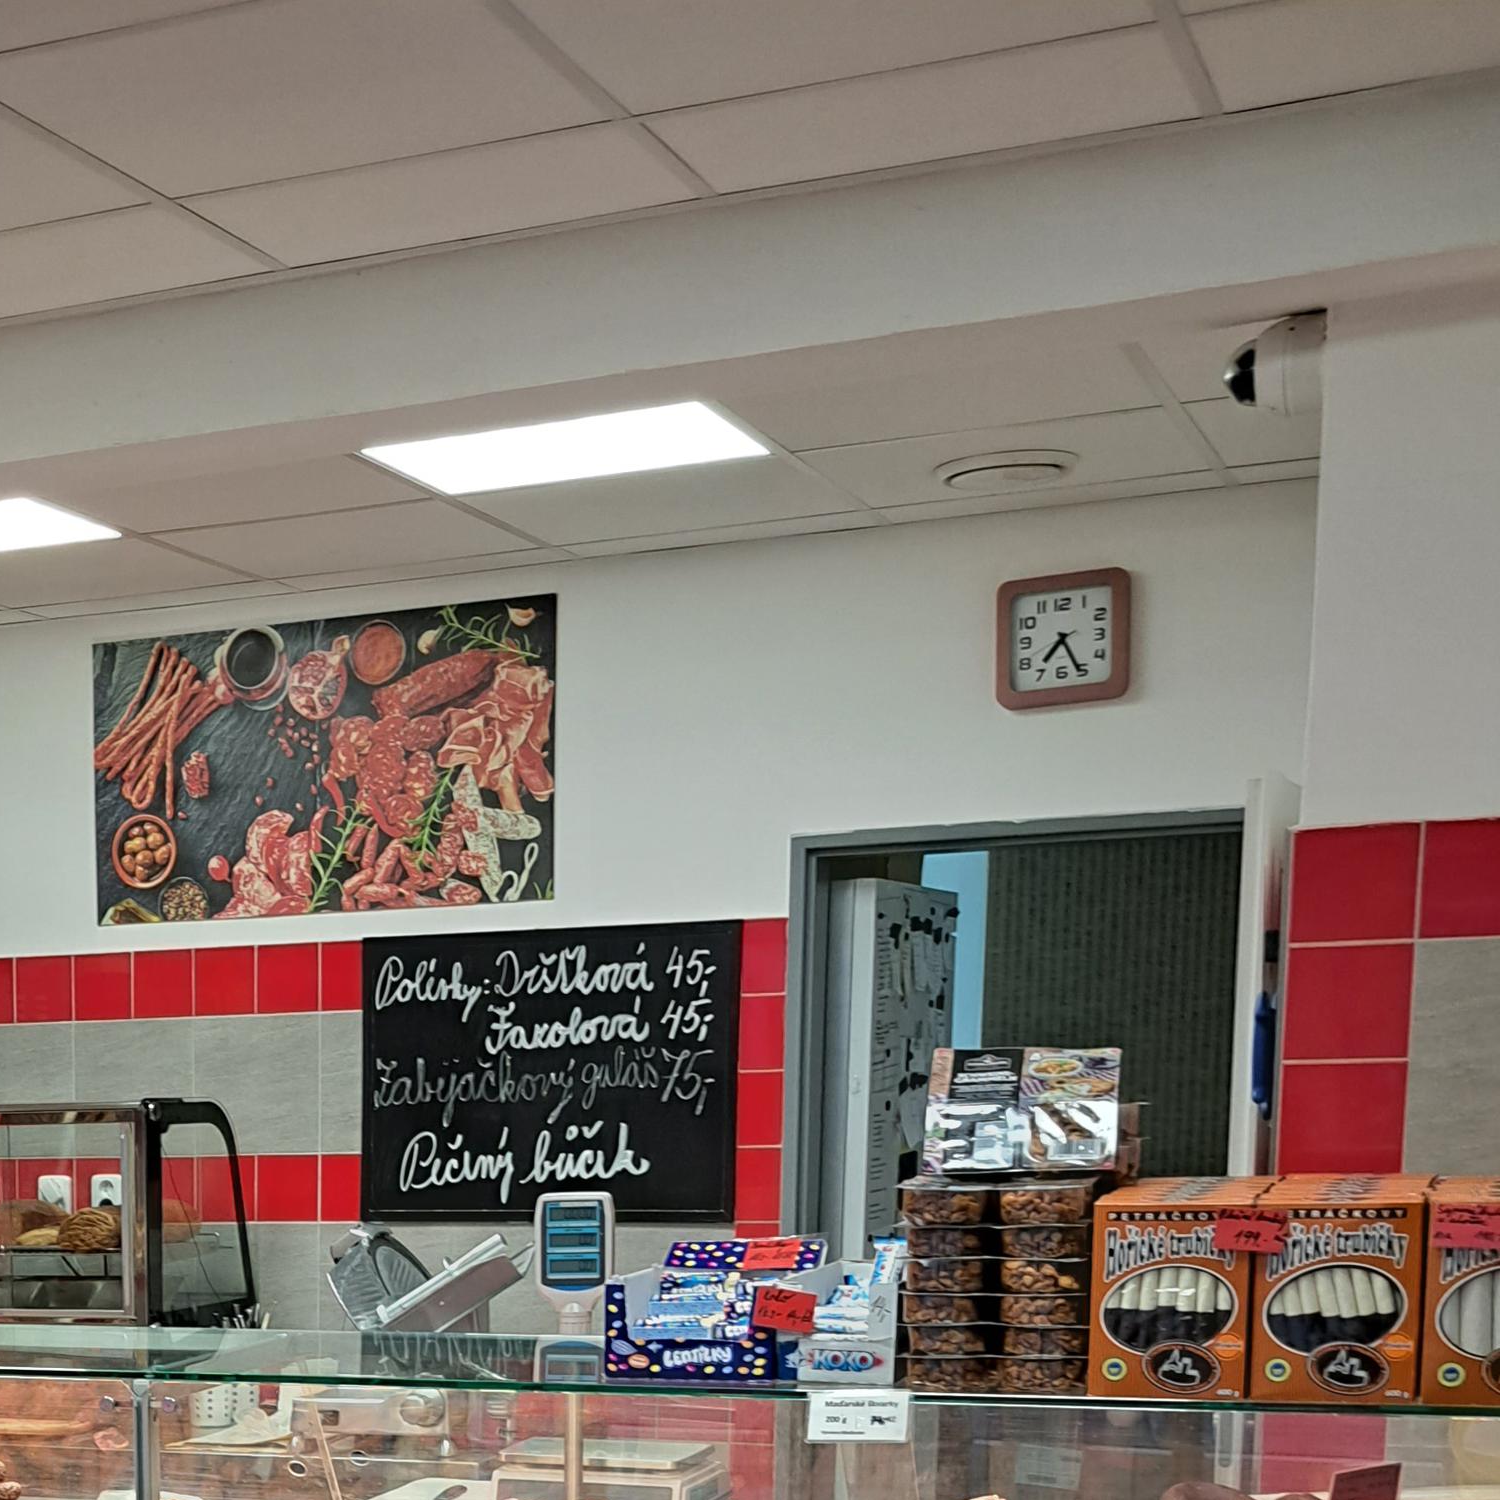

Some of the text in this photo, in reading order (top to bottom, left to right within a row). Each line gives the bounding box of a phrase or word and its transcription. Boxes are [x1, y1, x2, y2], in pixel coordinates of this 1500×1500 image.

[1037, 601, 1047, 614] 11
[1054, 598, 1072, 612] 12
[1093, 607, 1107, 621] 2
[1019, 617, 1037, 630] 10
[1093, 627, 1106, 641] 3
[1019, 636, 1032, 650] 9
[1093, 648, 1105, 661] 4
[1019, 657, 1032, 671] 8
[1035, 668, 1046, 682] 7
[1055, 666, 1068, 679] 6
[485, 996, 649, 1054] Fazolová
[1108, 1212, 1218, 1221] PETRÁČKO
[1287, 1209, 1404, 1219] ETRÁČKOVY
